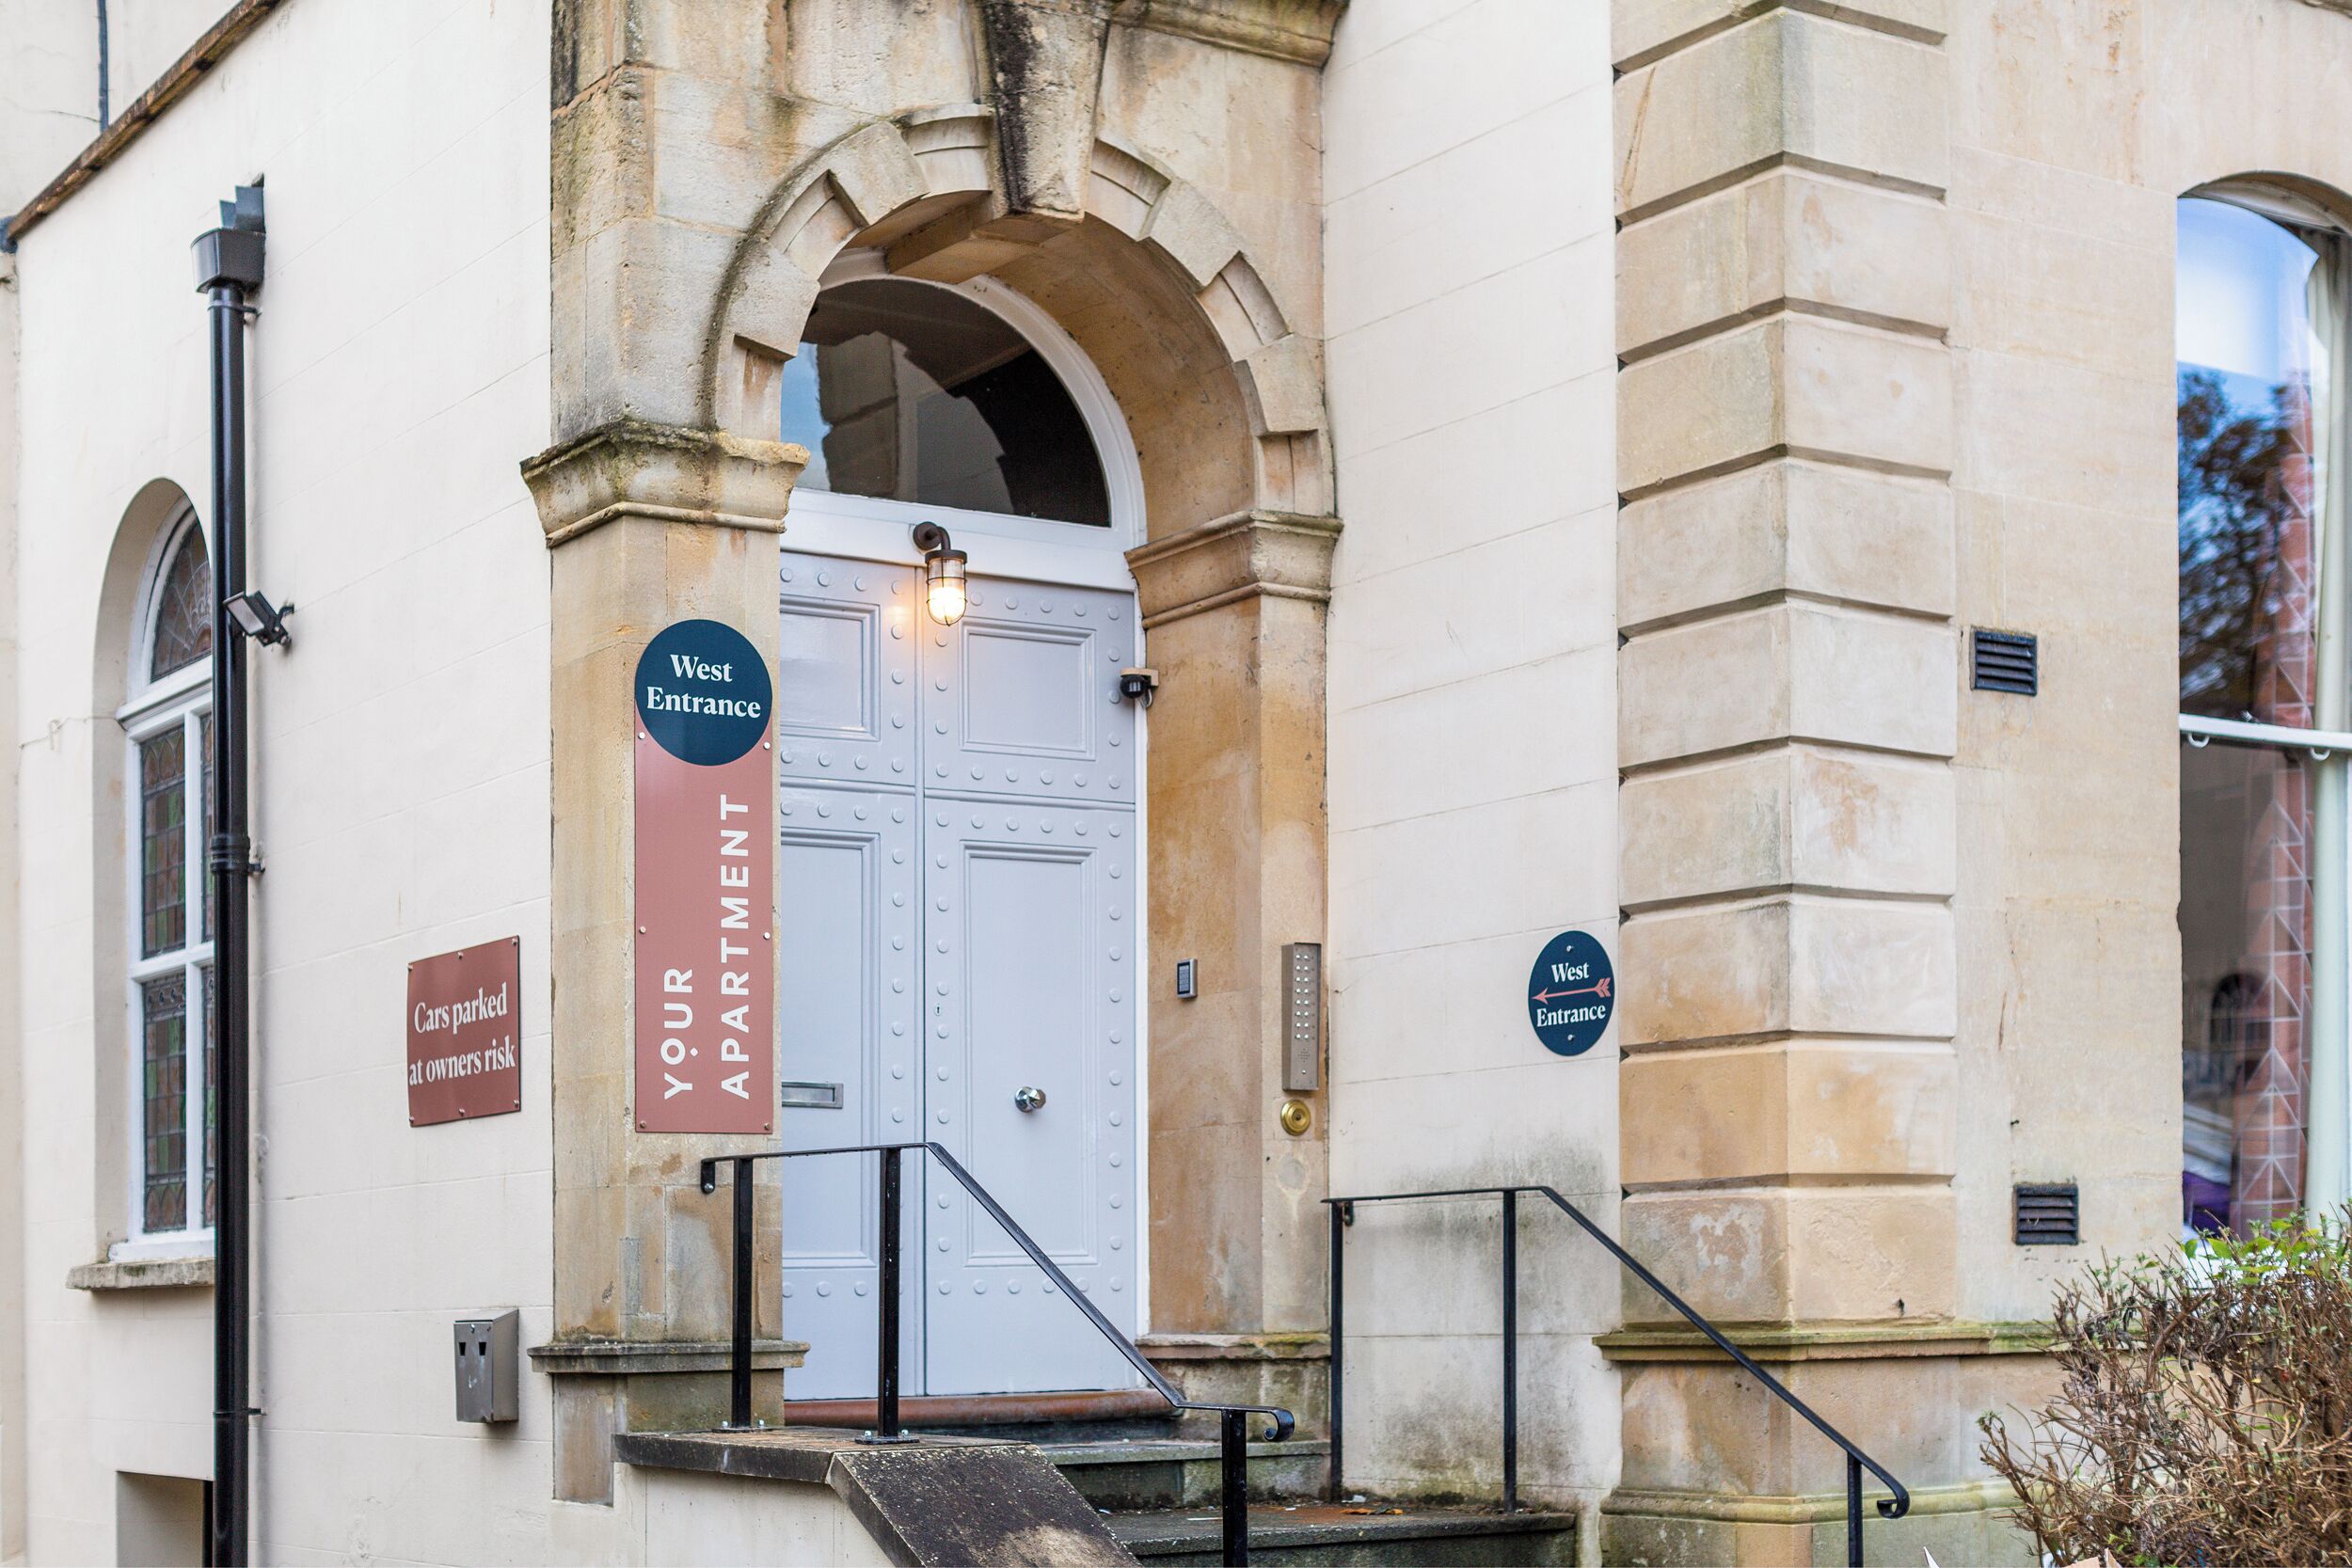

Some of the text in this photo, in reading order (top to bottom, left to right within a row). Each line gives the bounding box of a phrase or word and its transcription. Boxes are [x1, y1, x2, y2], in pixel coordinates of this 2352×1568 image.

[670, 654, 733, 683] West
[646, 686, 761, 719] Entrance
[720, 794, 750, 1100] APARTMENT
[1550, 961, 1590, 983] West
[414, 981, 508, 1035] Cars parked
[1536, 1004, 1607, 1027] Entrance
[660, 969, 698, 1100] YOUR
[408, 1035, 516, 1085] at owners risk
